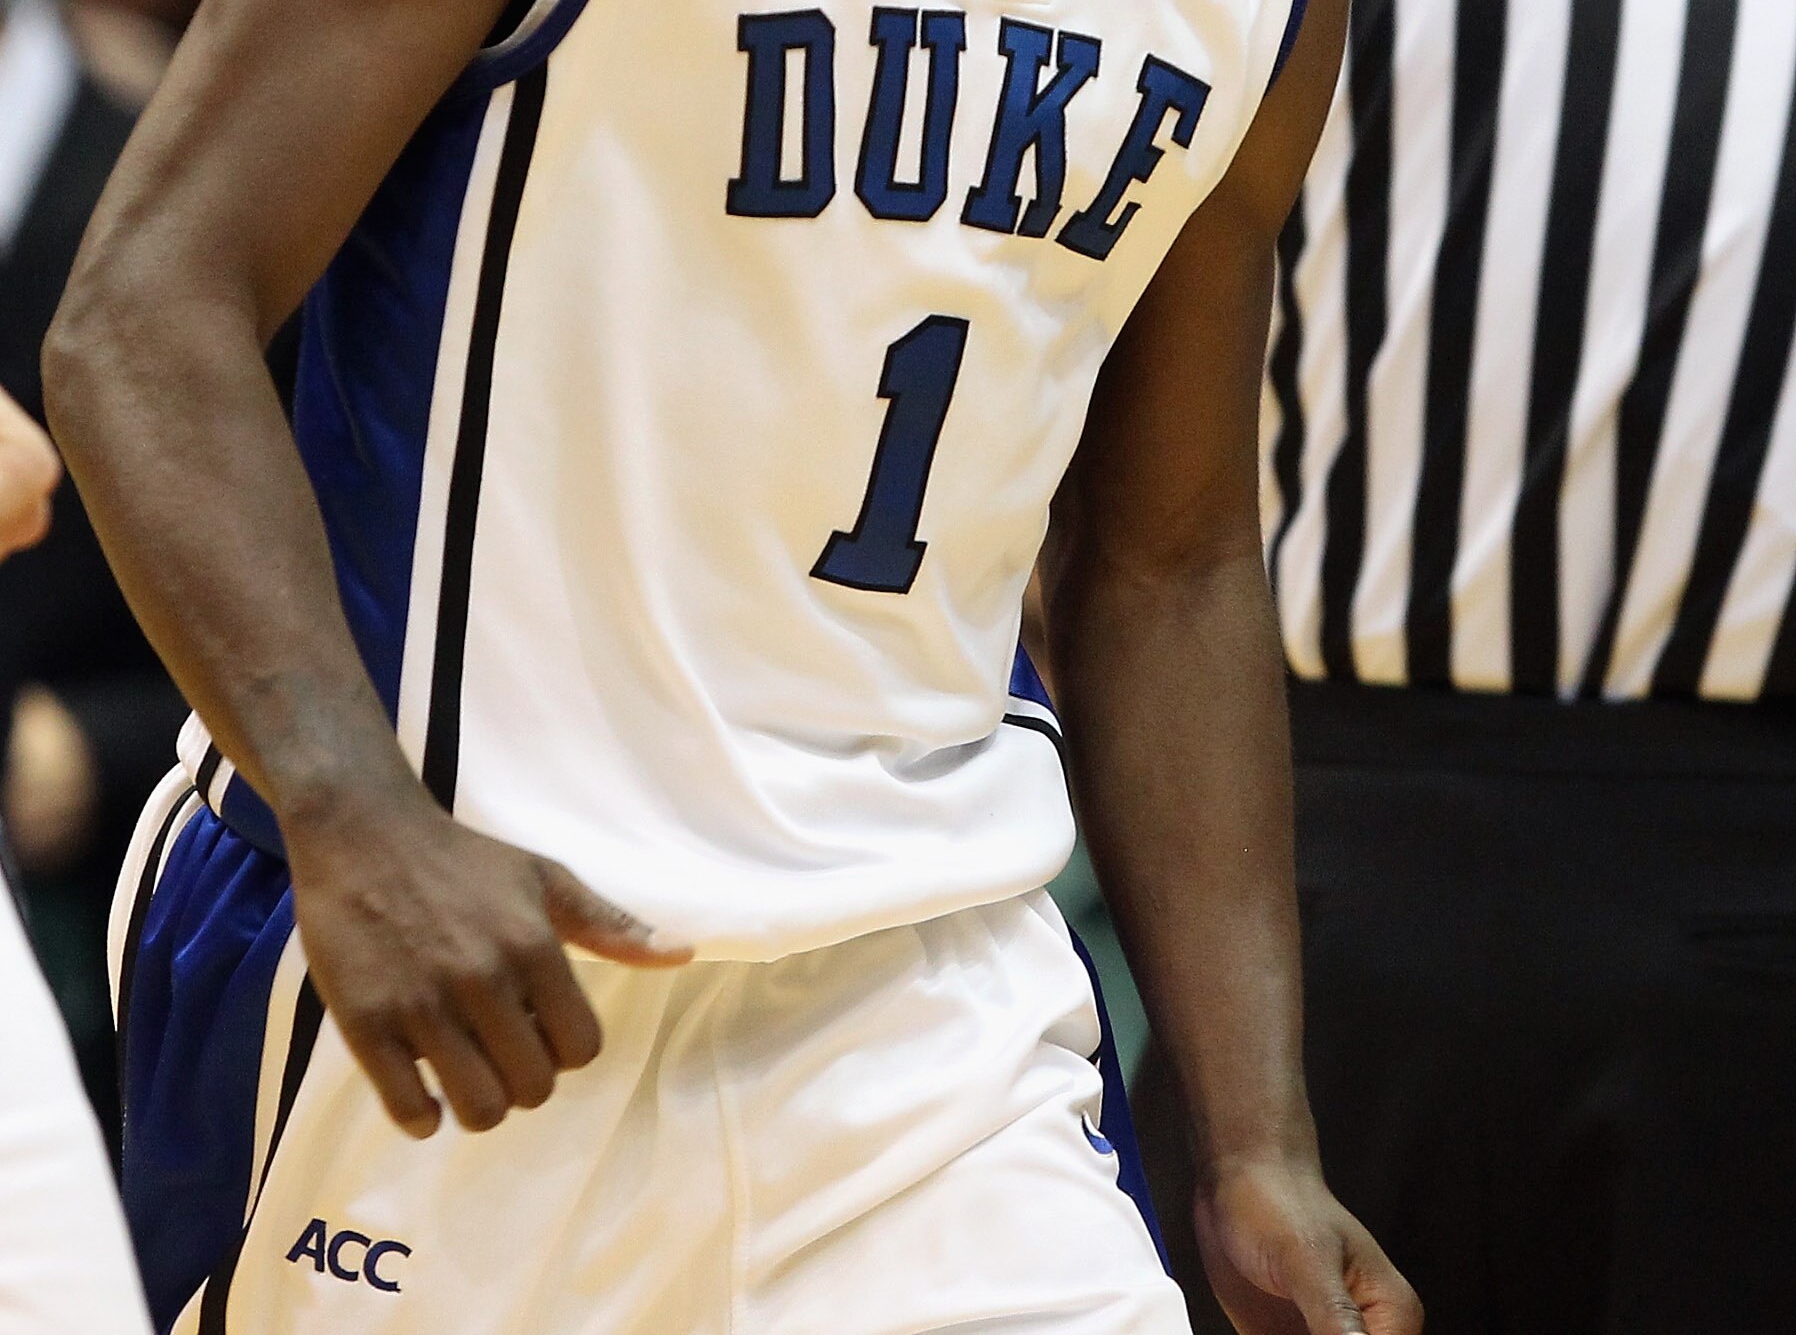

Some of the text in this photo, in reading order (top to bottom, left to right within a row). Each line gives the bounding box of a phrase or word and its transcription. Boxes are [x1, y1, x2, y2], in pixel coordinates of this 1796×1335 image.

[726, 7, 1212, 261] DUKE
[810, 315, 970, 594] 1
[286, 1218, 412, 1293] ACC
